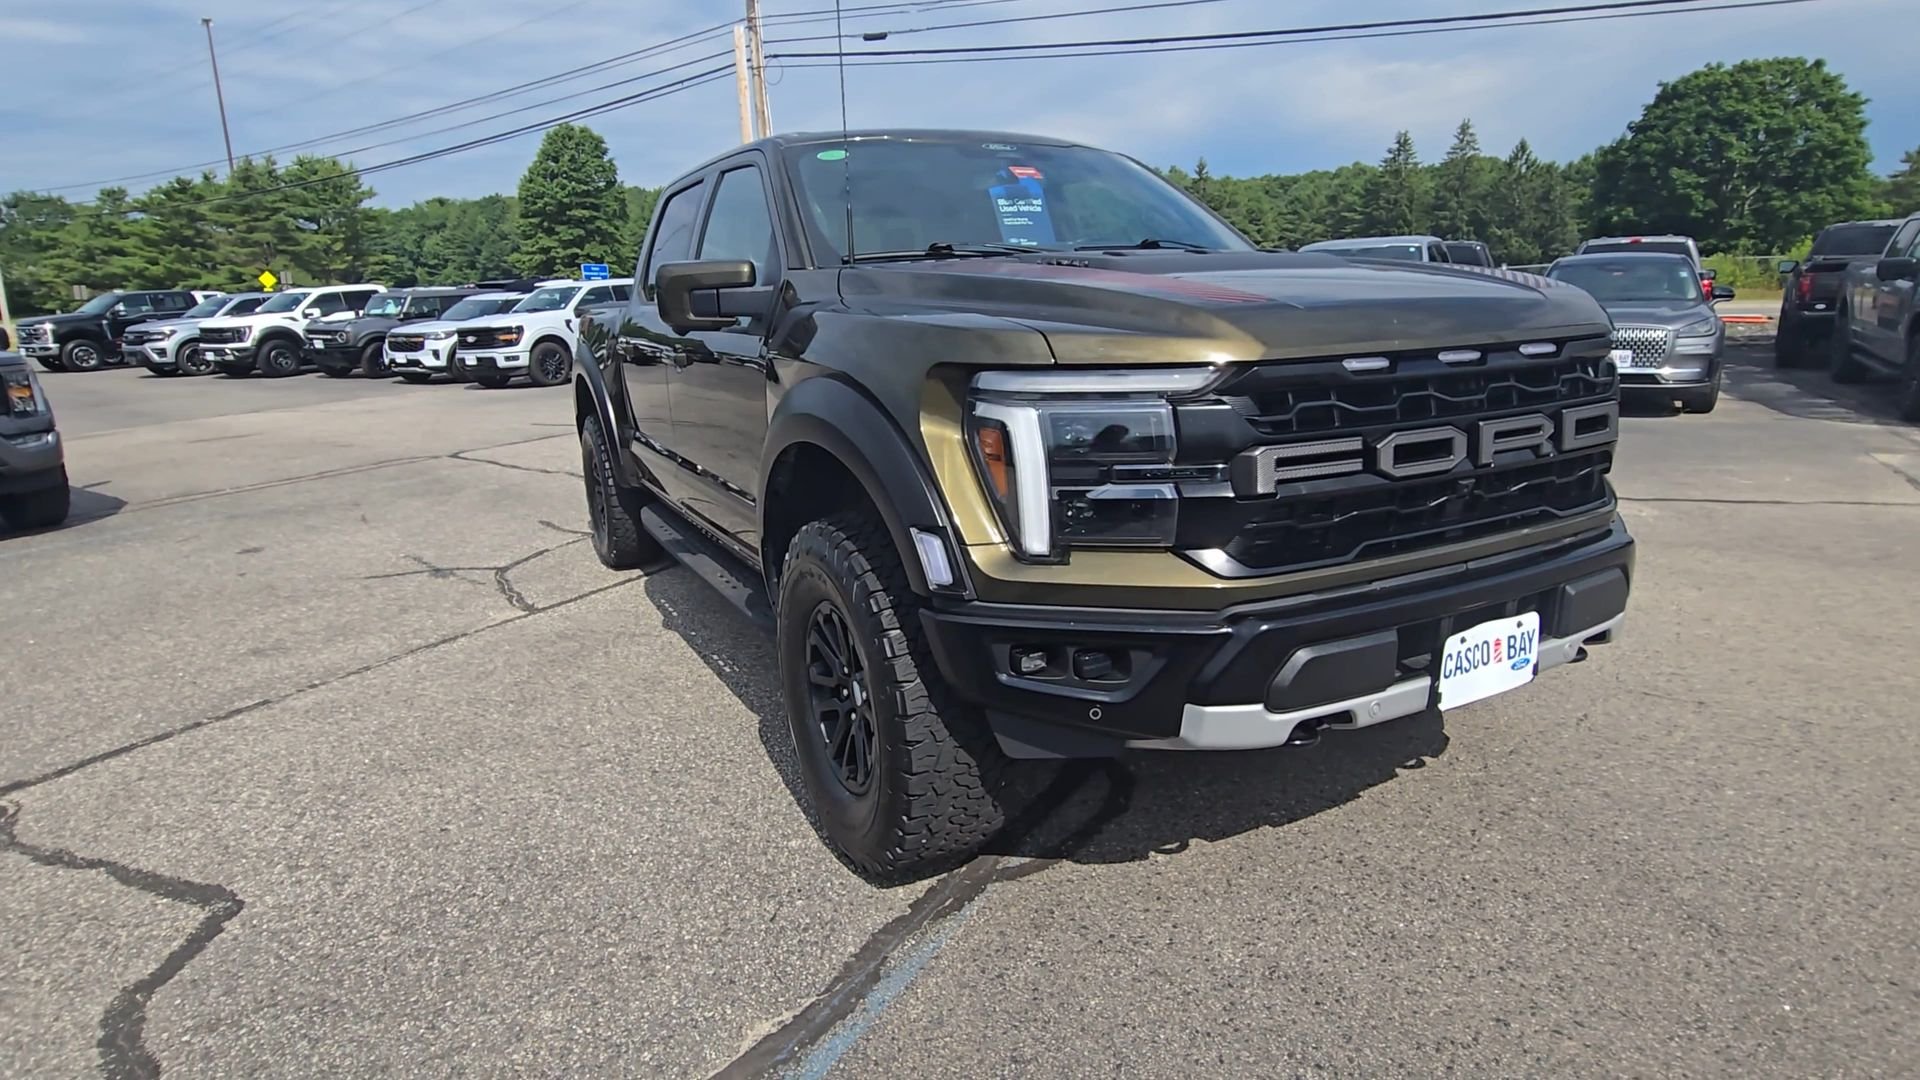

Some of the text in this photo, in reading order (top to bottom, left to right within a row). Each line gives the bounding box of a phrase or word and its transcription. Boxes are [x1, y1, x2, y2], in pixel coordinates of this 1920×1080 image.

[1238, 400, 1618, 498] FORD
[1443, 628, 1536, 679] CASCO BAY
